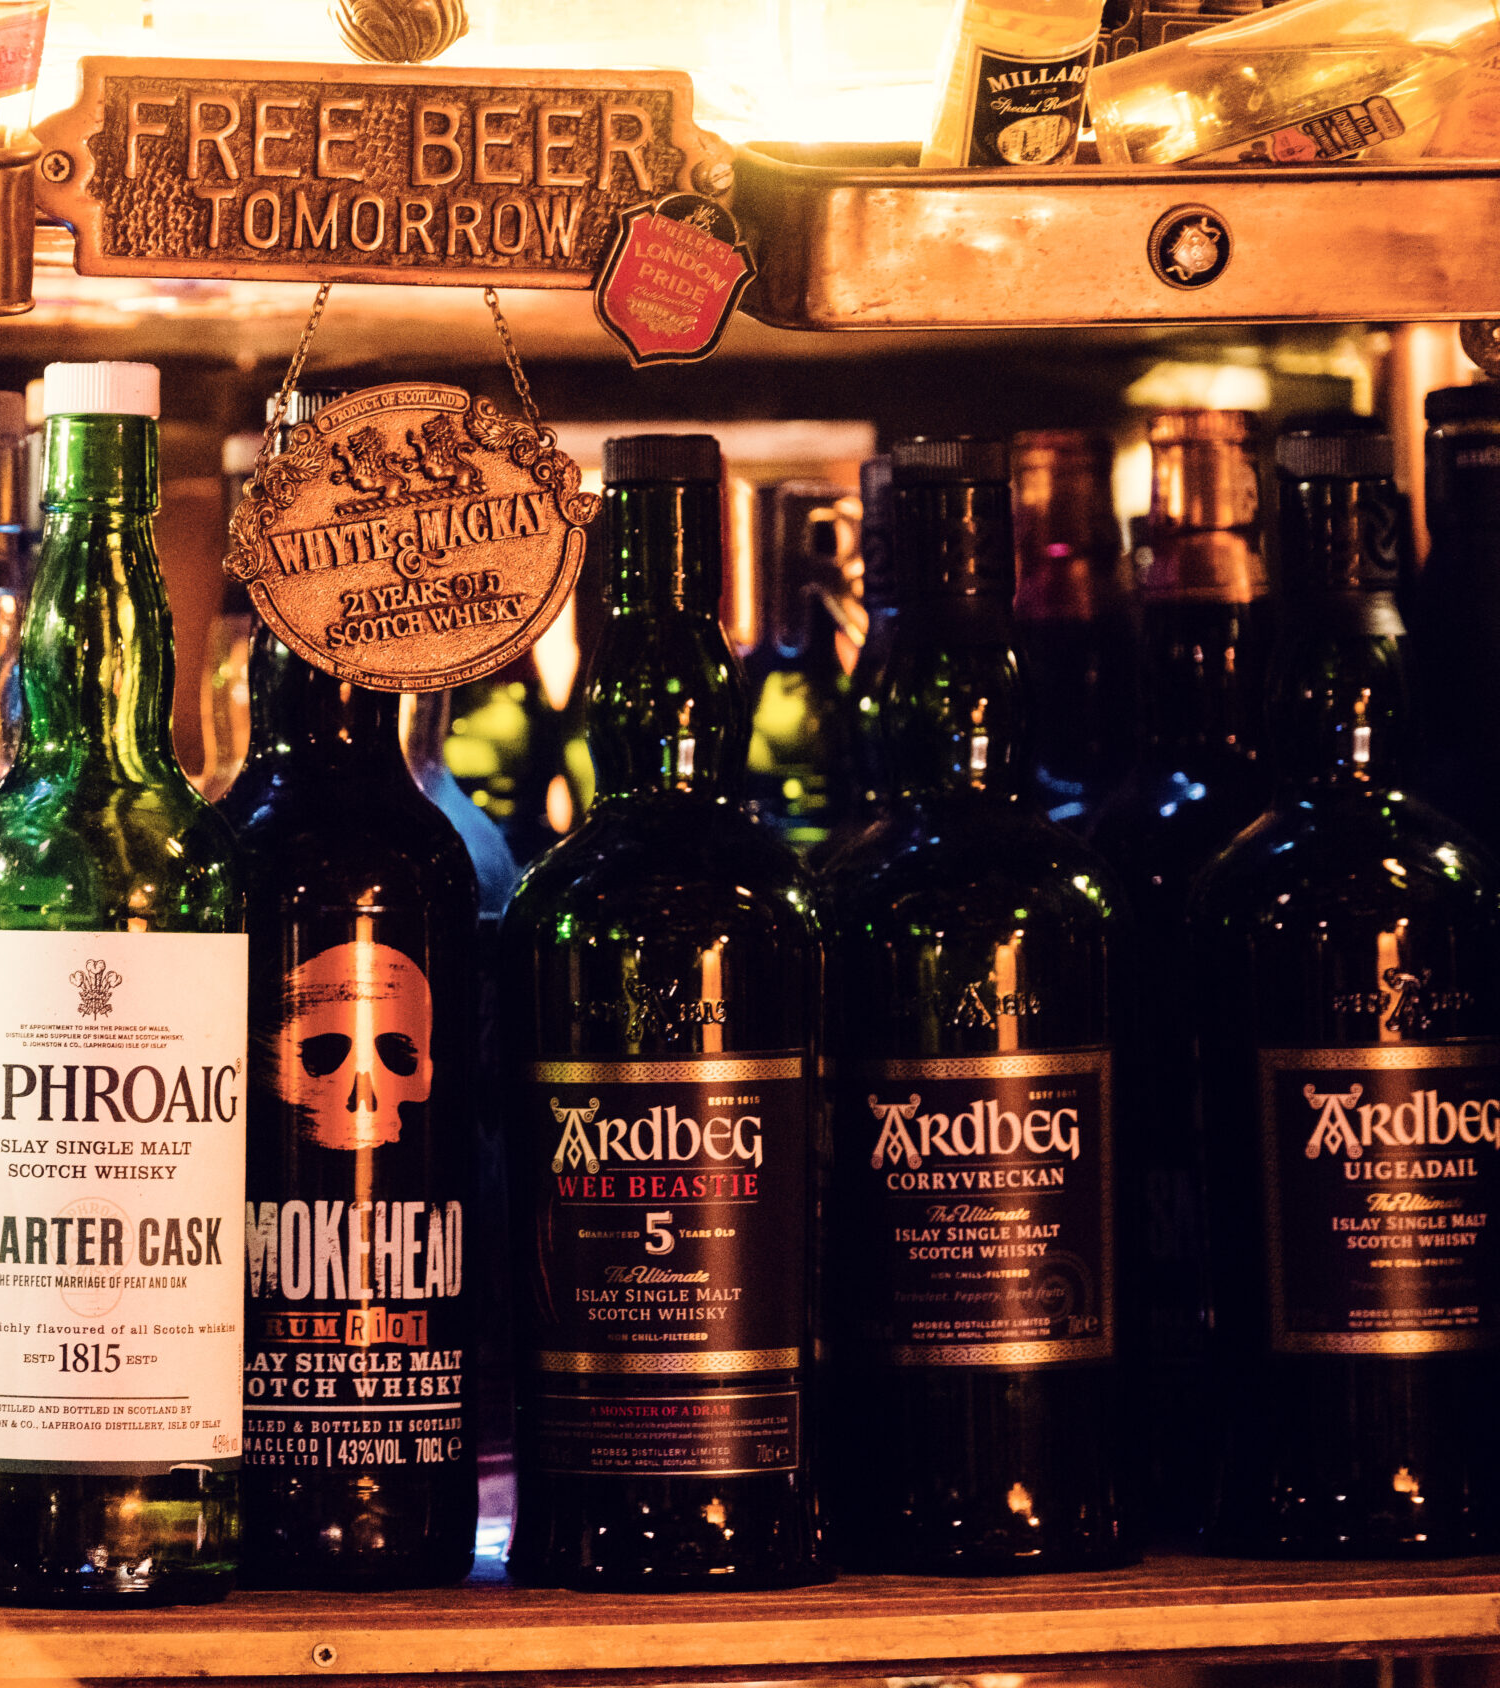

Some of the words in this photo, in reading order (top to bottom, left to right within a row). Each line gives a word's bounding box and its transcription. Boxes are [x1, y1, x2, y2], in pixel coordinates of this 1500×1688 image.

[126, 95, 367, 182] FREE
[411, 103, 653, 192] BEER
[197, 187, 584, 258] TOMORROW
[634, 241, 728, 294] LONDON
[637, 262, 710, 305] PRIDE
[330, 396, 376, 424] PRODUCT
[380, 393, 395, 408] OF
[396, 391, 456, 406] SCOTLAND
[416, 491, 551, 551] MACKAY
[270, 518, 395, 576] WHYTE
[395, 531, 452, 579] &
[344, 590, 372, 618] 21
[373, 577, 451, 611] YEARS
[454, 570, 506, 599] OLD
[328, 609, 426, 650] SCOTCH
[431, 596, 527, 632] WHISKY
[886, 1167, 1065, 1191] CORRYVRECKAN
[1344, 1158, 1478, 1181] UIGEADAIL
[557, 1176, 616, 1199] WEE
[628, 1174, 759, 1198] BEASTIE
[137, 1216, 224, 1268] CASK
[645, 1210, 675, 1256] 5
[245, 1199, 463, 1301] MOKEHEAD
[13, 1274, 53, 1288] PERFECT
[54, 1275, 107, 1289] MARRIAGE
[108, 1276, 122, 1289] OF
[123, 1276, 147, 1289] PEAT
[149, 1276, 168, 1289] AND
[169, 1276, 188, 1289] OAK
[576, 1287, 619, 1302] ISLAY
[625, 1288, 690, 1302] SINGLE
[696, 1287, 743, 1301] MALT
[37, 1323, 106, 1335] flavoured
[111, 1323, 127, 1335] of
[130, 1323, 148, 1335] all
[153, 1323, 195, 1335] Scotch
[266, 1318, 338, 1338] RUM
[588, 1307, 651, 1321] SCOTCH
[658, 1306, 729, 1320] WHISKY
[58, 1342, 121, 1374] 1815
[295, 1352, 402, 1373] SINGLE
[409, 1350, 463, 1372] MALT
[352, 1375, 463, 1398] WHISKY
[38, 1404, 60, 1414] AND
[62, 1405, 110, 1415] BOTTLED
[112, 1405, 124, 1415] IN
[126, 1405, 178, 1415] SCOTLAND
[180, 1405, 192, 1415] BY
[414, 1436, 445, 1464] 70CL
